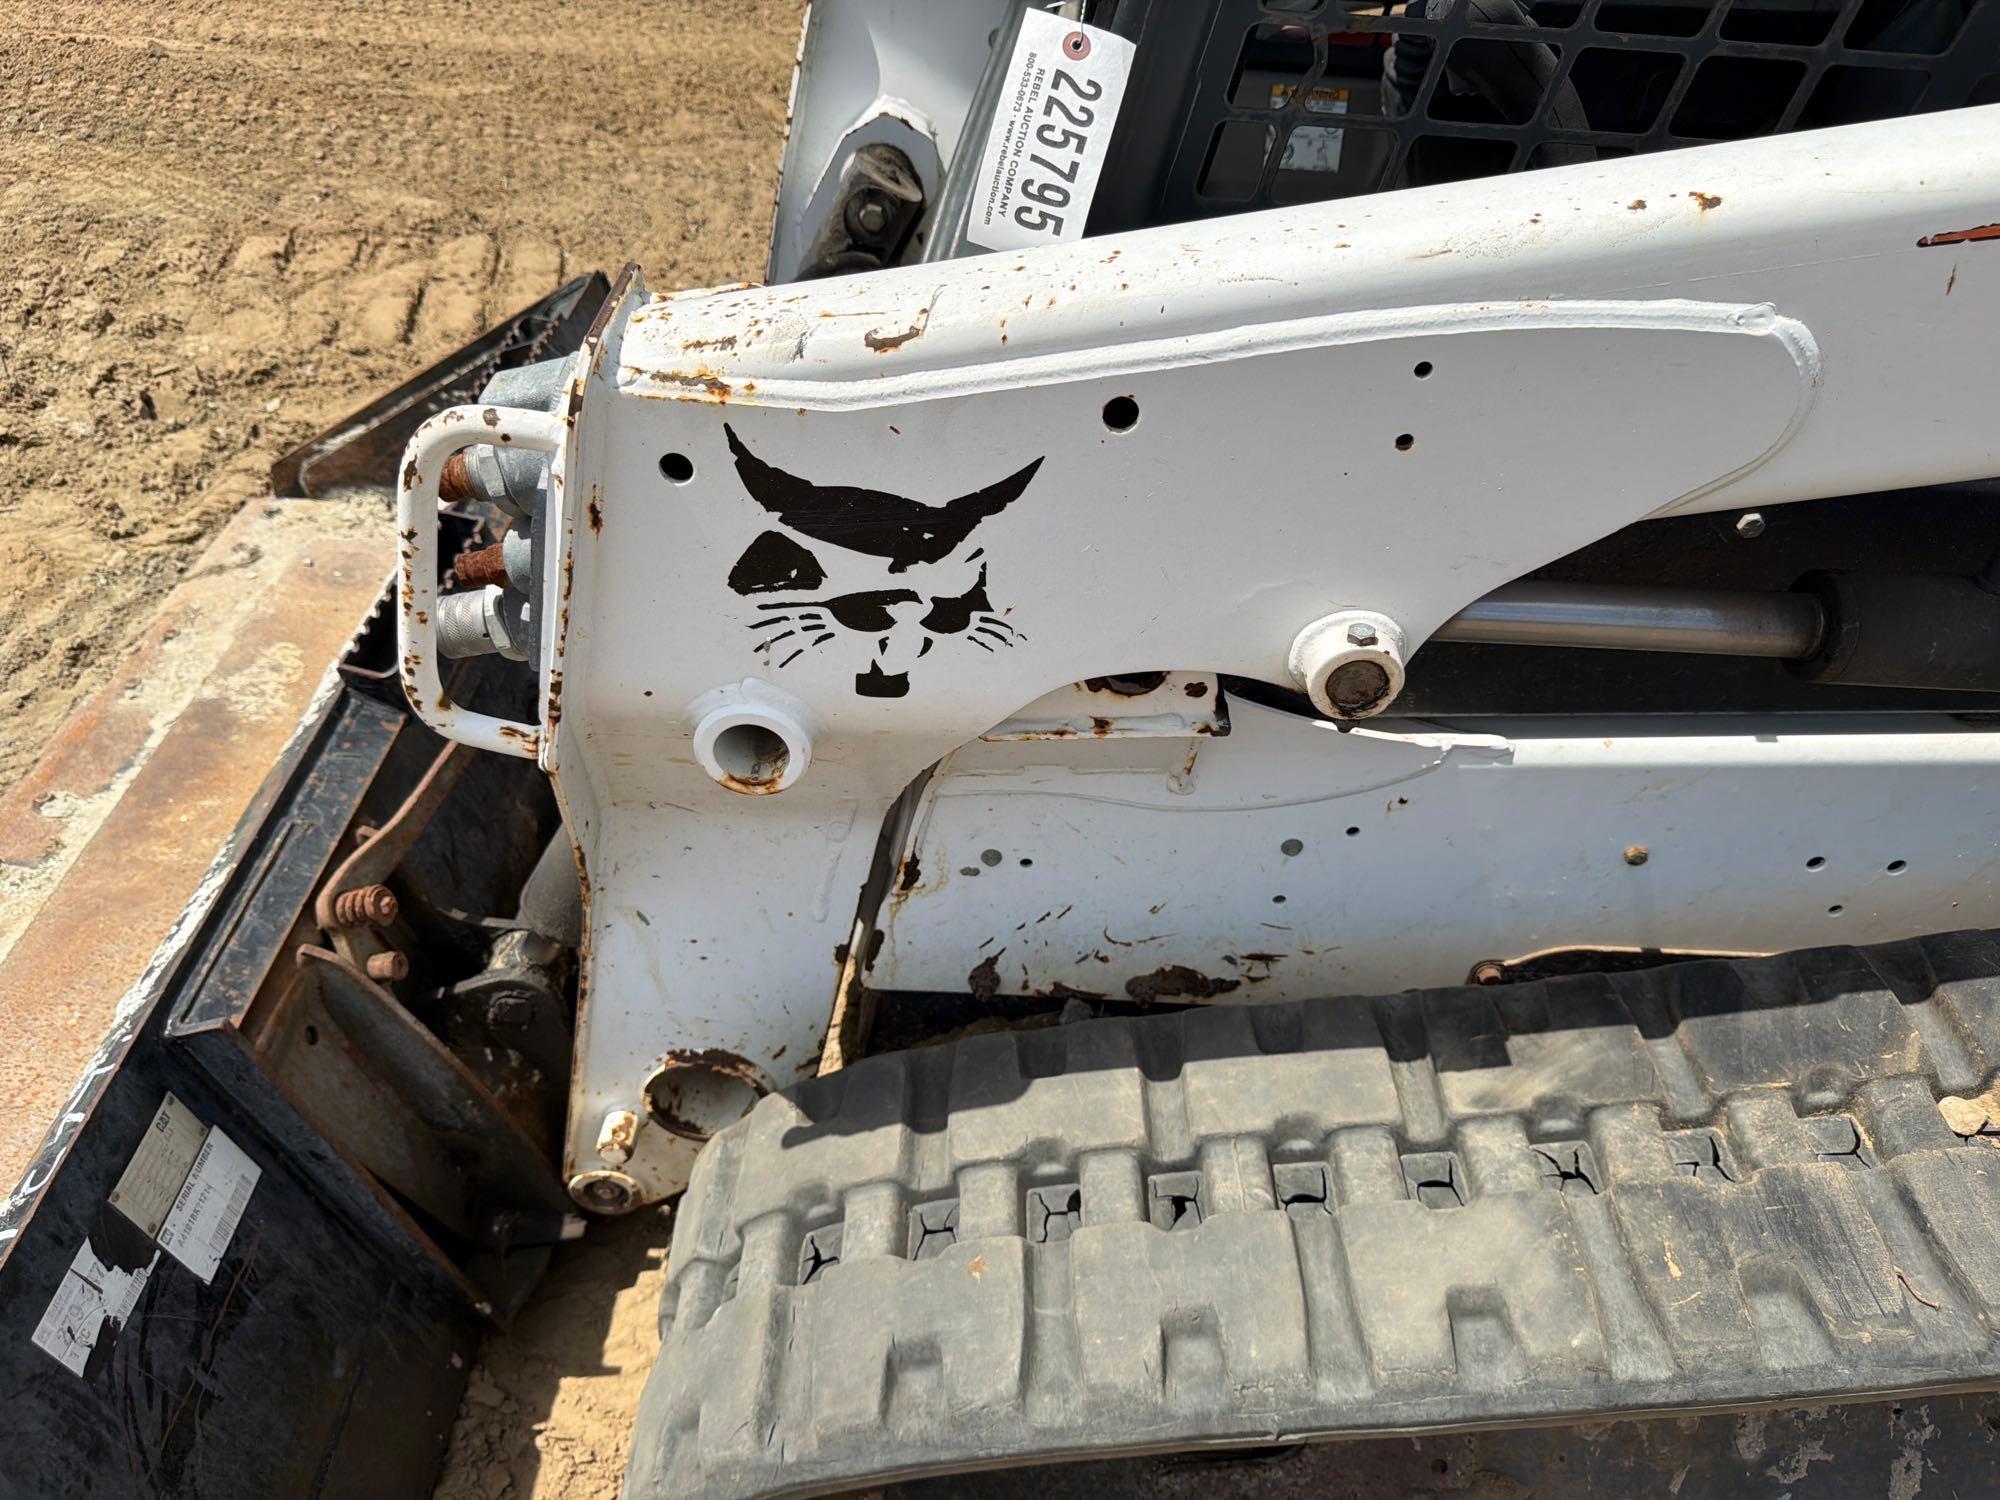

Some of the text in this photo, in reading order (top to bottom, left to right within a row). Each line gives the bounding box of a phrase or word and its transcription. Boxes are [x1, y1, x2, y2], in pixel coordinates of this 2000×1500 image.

[984, 52, 1038, 226] 800-533-0673 www.rebelauction.com
[997, 68, 1046, 218] REBEL AUCTION COMPANY
[1014, 68, 1103, 238] 225795
[155, 1112, 172, 1133] CAT
[175, 1142, 214, 1213] SERIAL NUMBER
